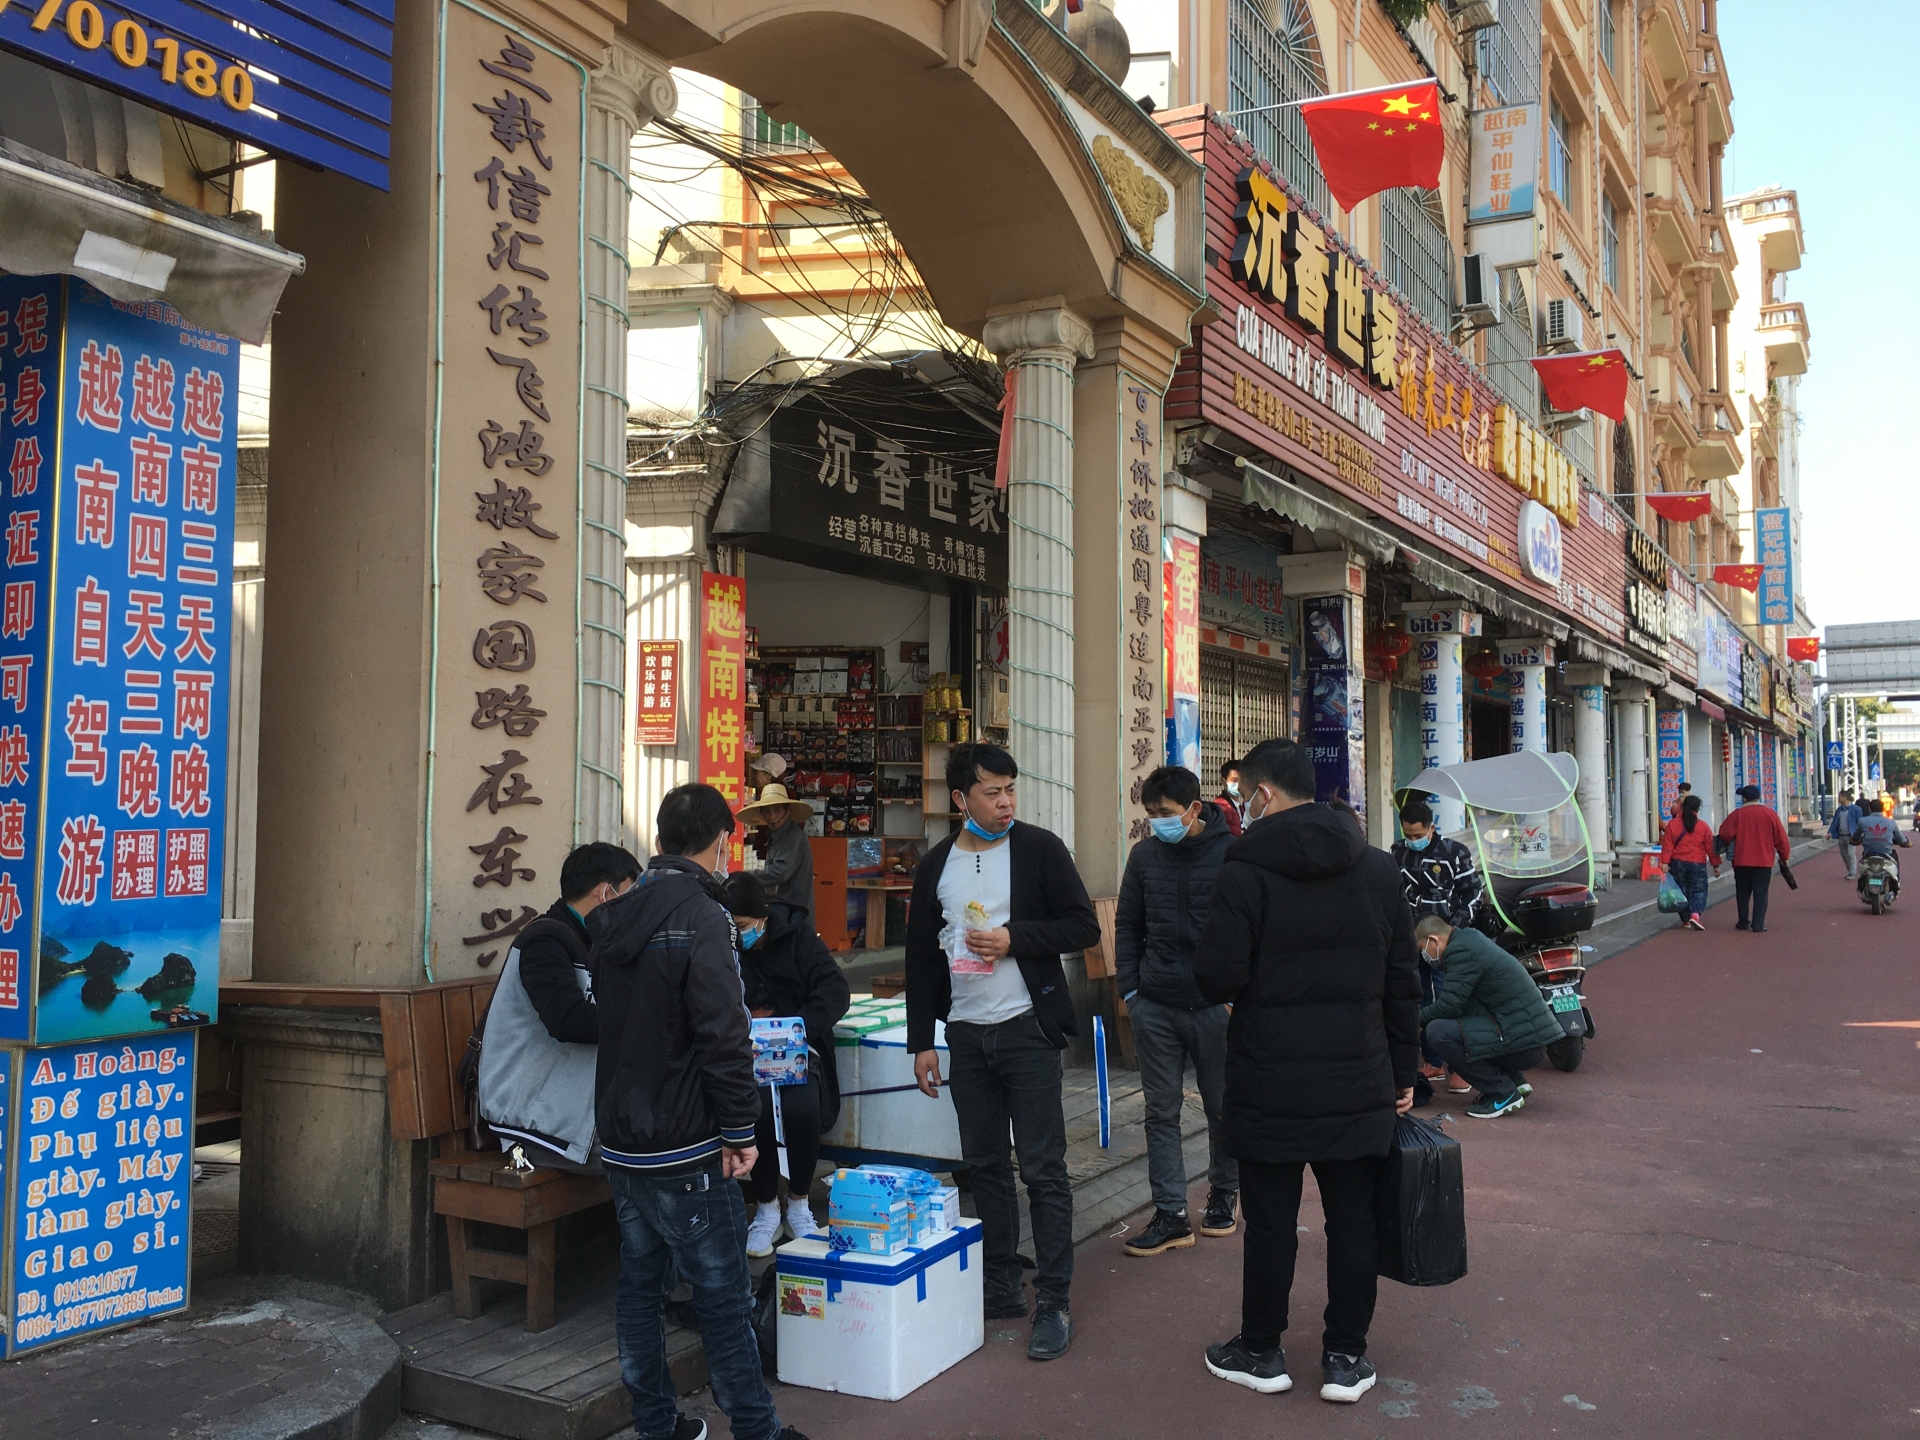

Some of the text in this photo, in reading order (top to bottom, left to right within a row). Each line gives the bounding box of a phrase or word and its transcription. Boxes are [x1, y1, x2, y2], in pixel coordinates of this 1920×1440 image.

[1483, 109, 1528, 132] 越南
[1489, 131, 1514, 213] 平仙鞋业
[1240, 167, 1398, 391] 沉香世家
[179, 332, 229, 355] 第十经营部
[817, 418, 1006, 535] 沉香世家
[828, 514, 987, 565] 经营 各种高档佛珠 奇楠沉香
[858, 534, 988, 583] 沉香工艺品 可大小量批发
[117, 354, 175, 819] 越南四天三晚
[170, 366, 224, 818] 越南三天两晚
[1199, 555, 1285, 618] 南平仙鞋业
[1761, 513, 1790, 623] 蓝记越南风味
[56, 339, 124, 907] 越南自驾游
[1173, 548, 1198, 688] 香烟
[1263, 615, 1285, 638] 专卖店
[643, 655, 657, 708] 欢乐旅游
[659, 655, 673, 708] 健康生活
[117, 834, 156, 864] 护照
[169, 833, 207, 862] 护照
[115, 866, 155, 897] 办理
[168, 864, 205, 893] 办理
[31, 1046, 186, 1086] A. Hoàng.
[31, 1080, 185, 1125] Đế giày.
[29, 1114, 184, 1164] Phụ liệu
[26, 1149, 183, 1209] giày. Máy
[25, 1188, 181, 1241] làm giày.
[25, 1221, 180, 1279] Giao sỉ.
[53, 1265, 139, 1307] 0919210577
[16, 1284, 183, 1344] 0086-13877072885 WeChat
